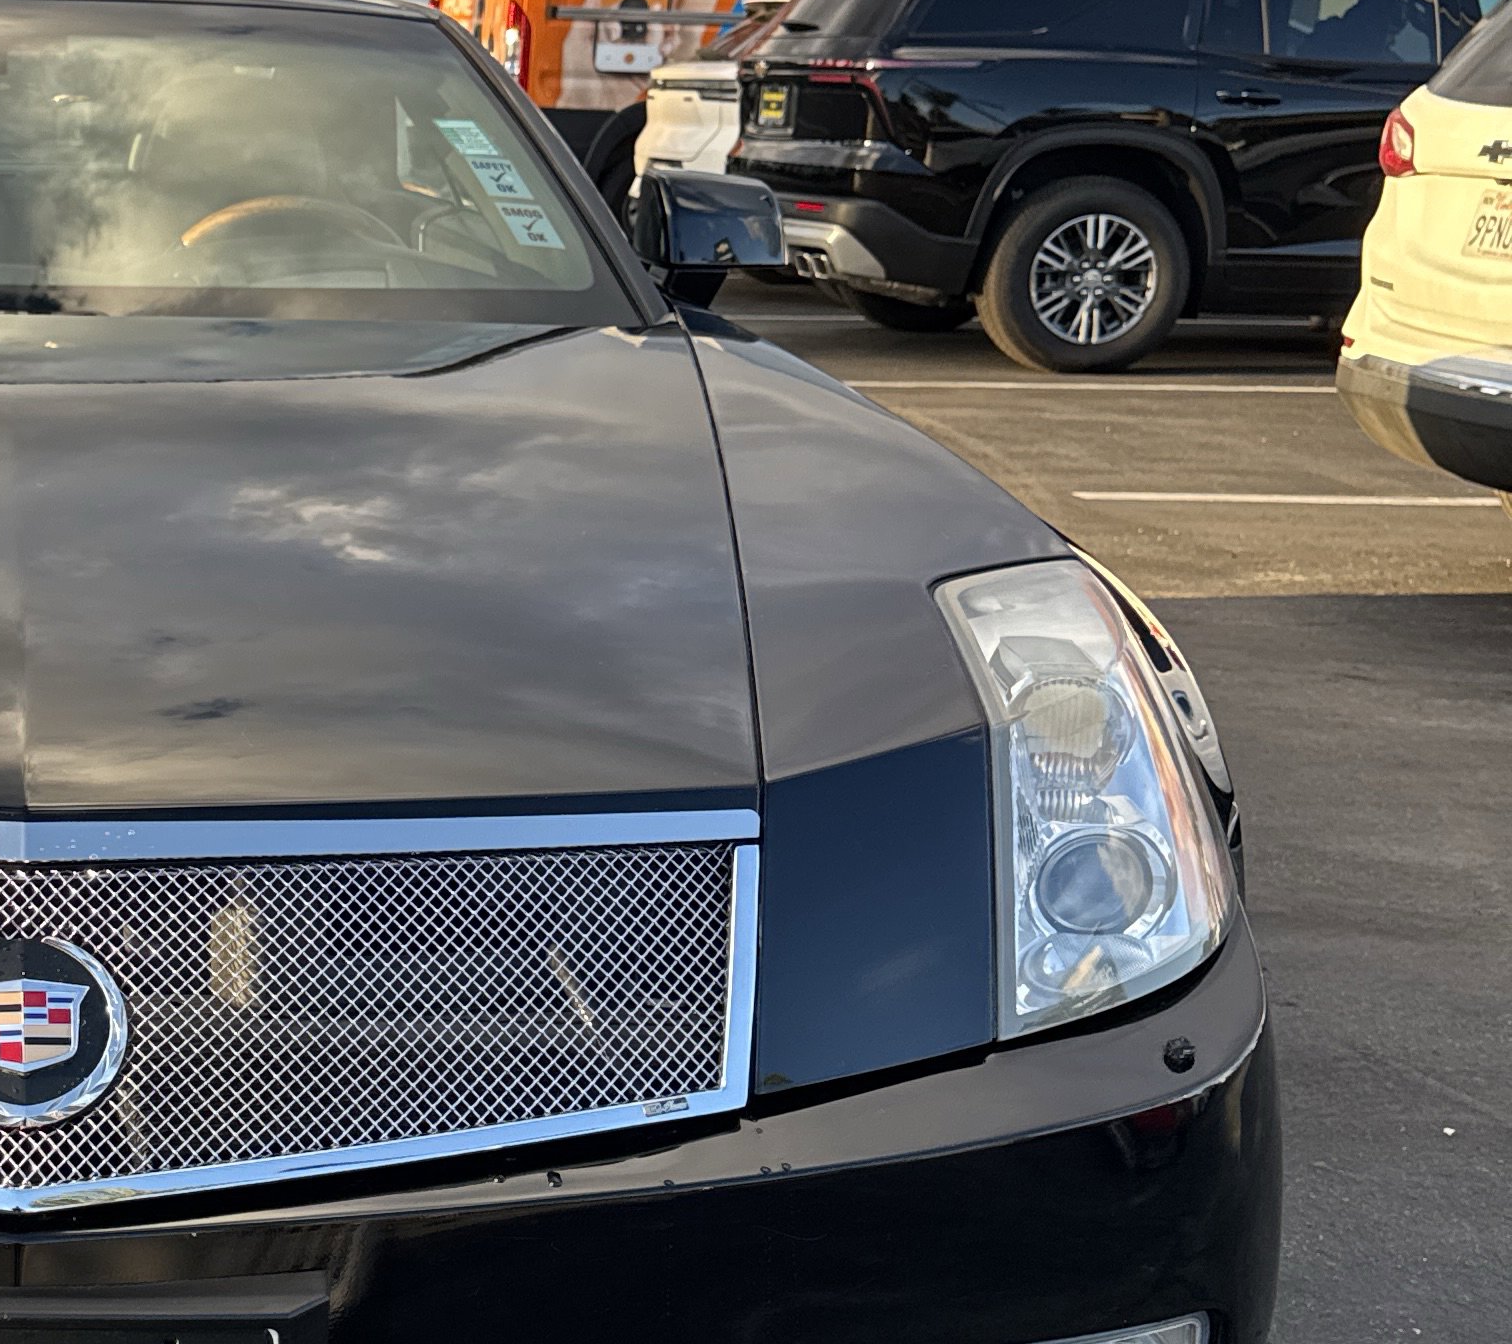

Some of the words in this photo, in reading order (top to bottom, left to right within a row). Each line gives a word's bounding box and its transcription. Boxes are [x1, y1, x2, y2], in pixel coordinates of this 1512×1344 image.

[471, 160, 513, 172] SAFETY
[496, 183, 518, 194] OK
[501, 206, 544, 219] SMOG
[526, 232, 548, 243] OK
